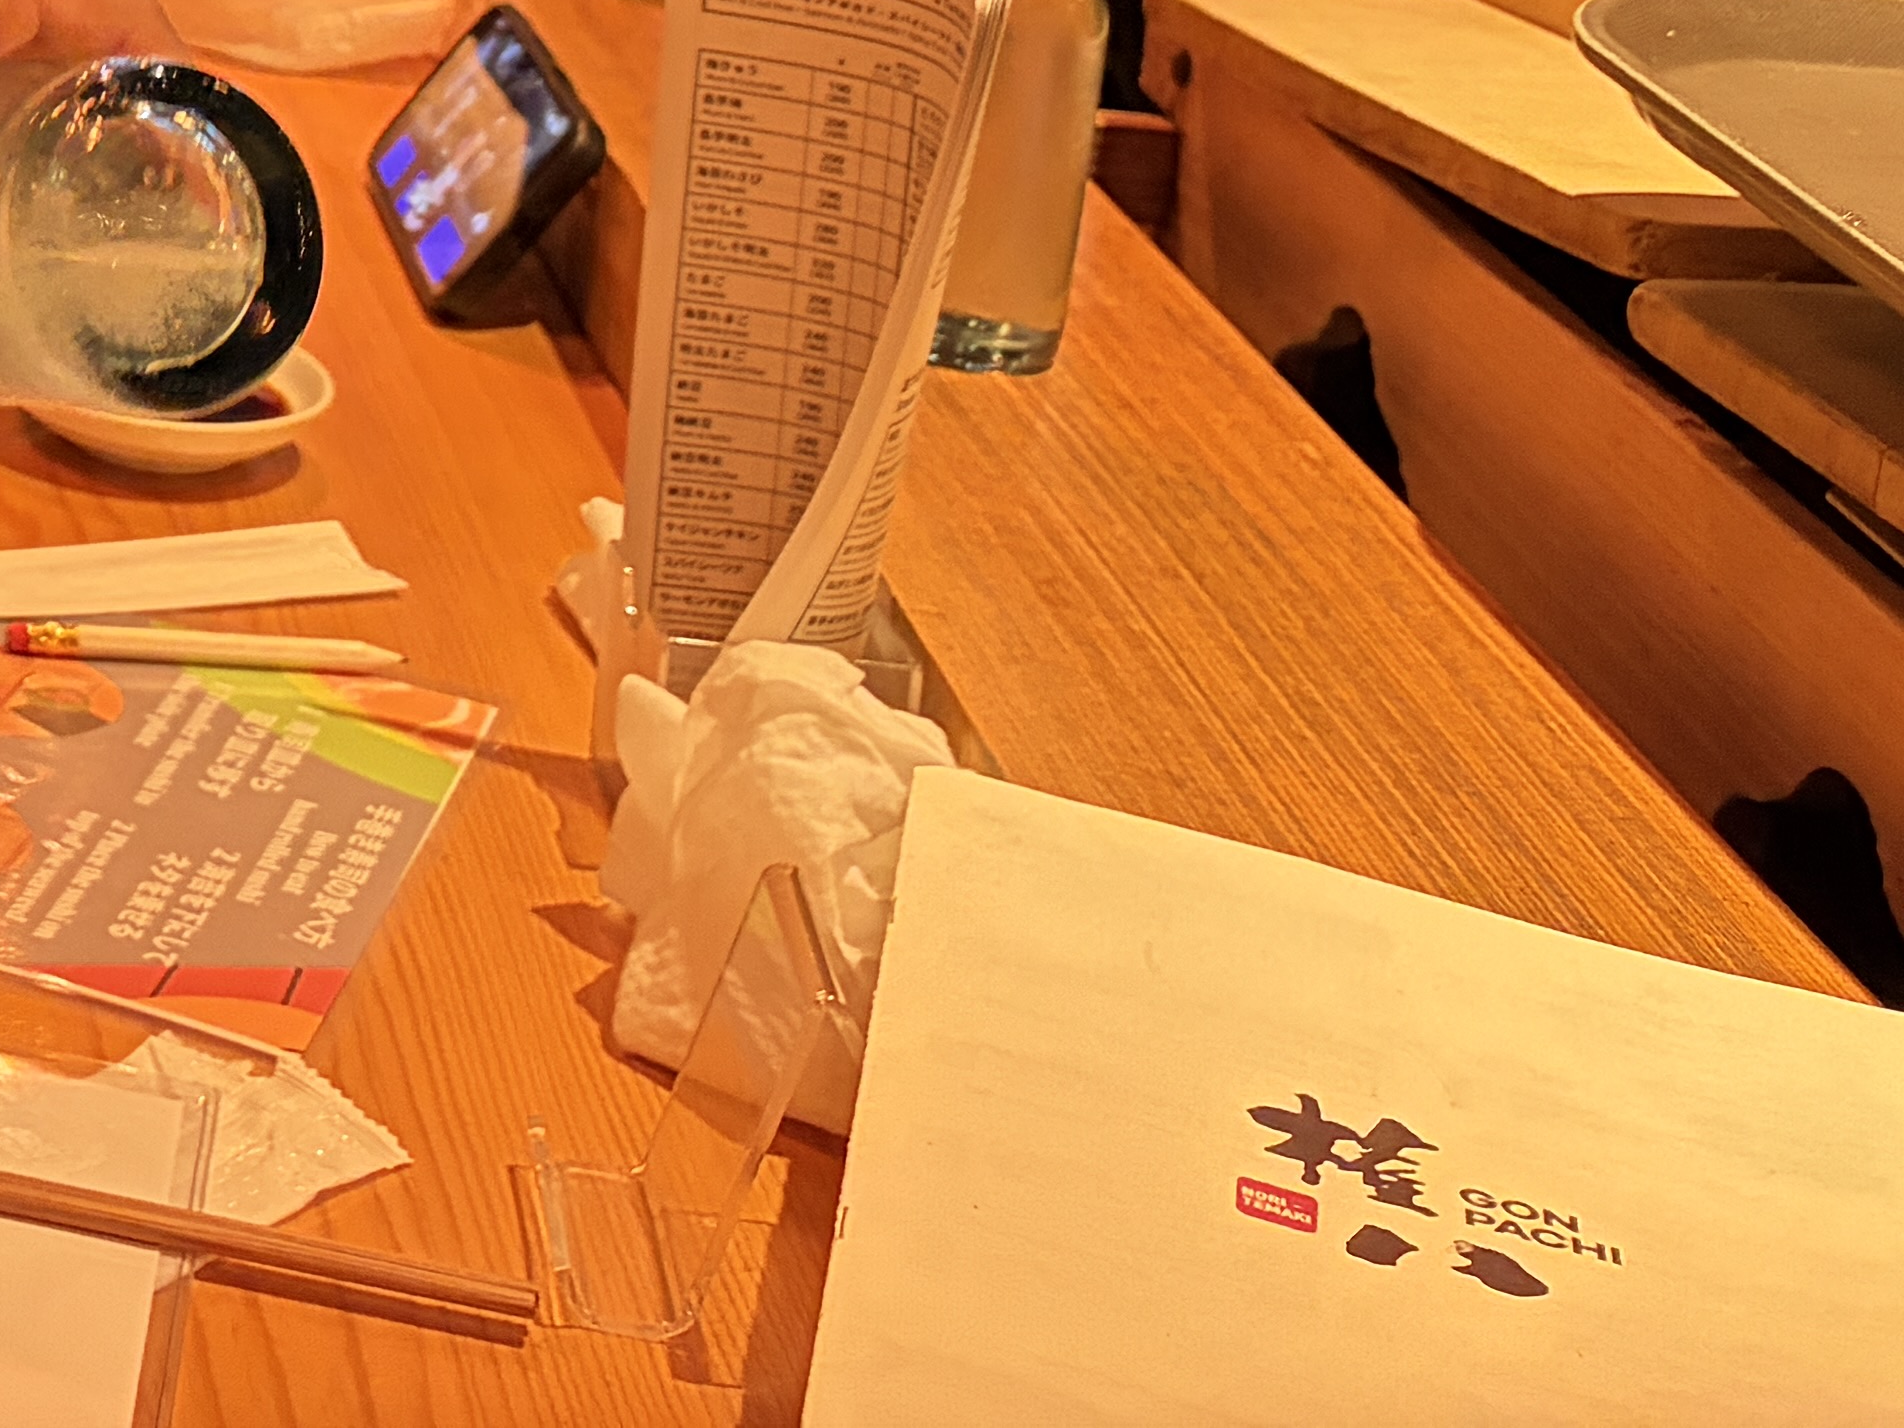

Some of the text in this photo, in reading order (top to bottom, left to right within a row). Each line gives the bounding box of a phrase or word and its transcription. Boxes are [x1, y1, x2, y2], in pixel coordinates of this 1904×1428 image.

[85, 830, 129, 867] Place
[235, 798, 319, 906] hand rolled sushi
[292, 803, 403, 949] 手巻き寿司の食べ方
[4, 866, 58, 923] seaweed
[45, 886, 85, 924] sushi
[108, 851, 192, 940] ネタを乗せる
[141, 860, 236, 968] 海苔を下にして
[1242, 1195, 1312, 1225] TEMAKI
[1458, 1187, 1580, 1234] GON
[1464, 1208, 1625, 1266] PACHI
